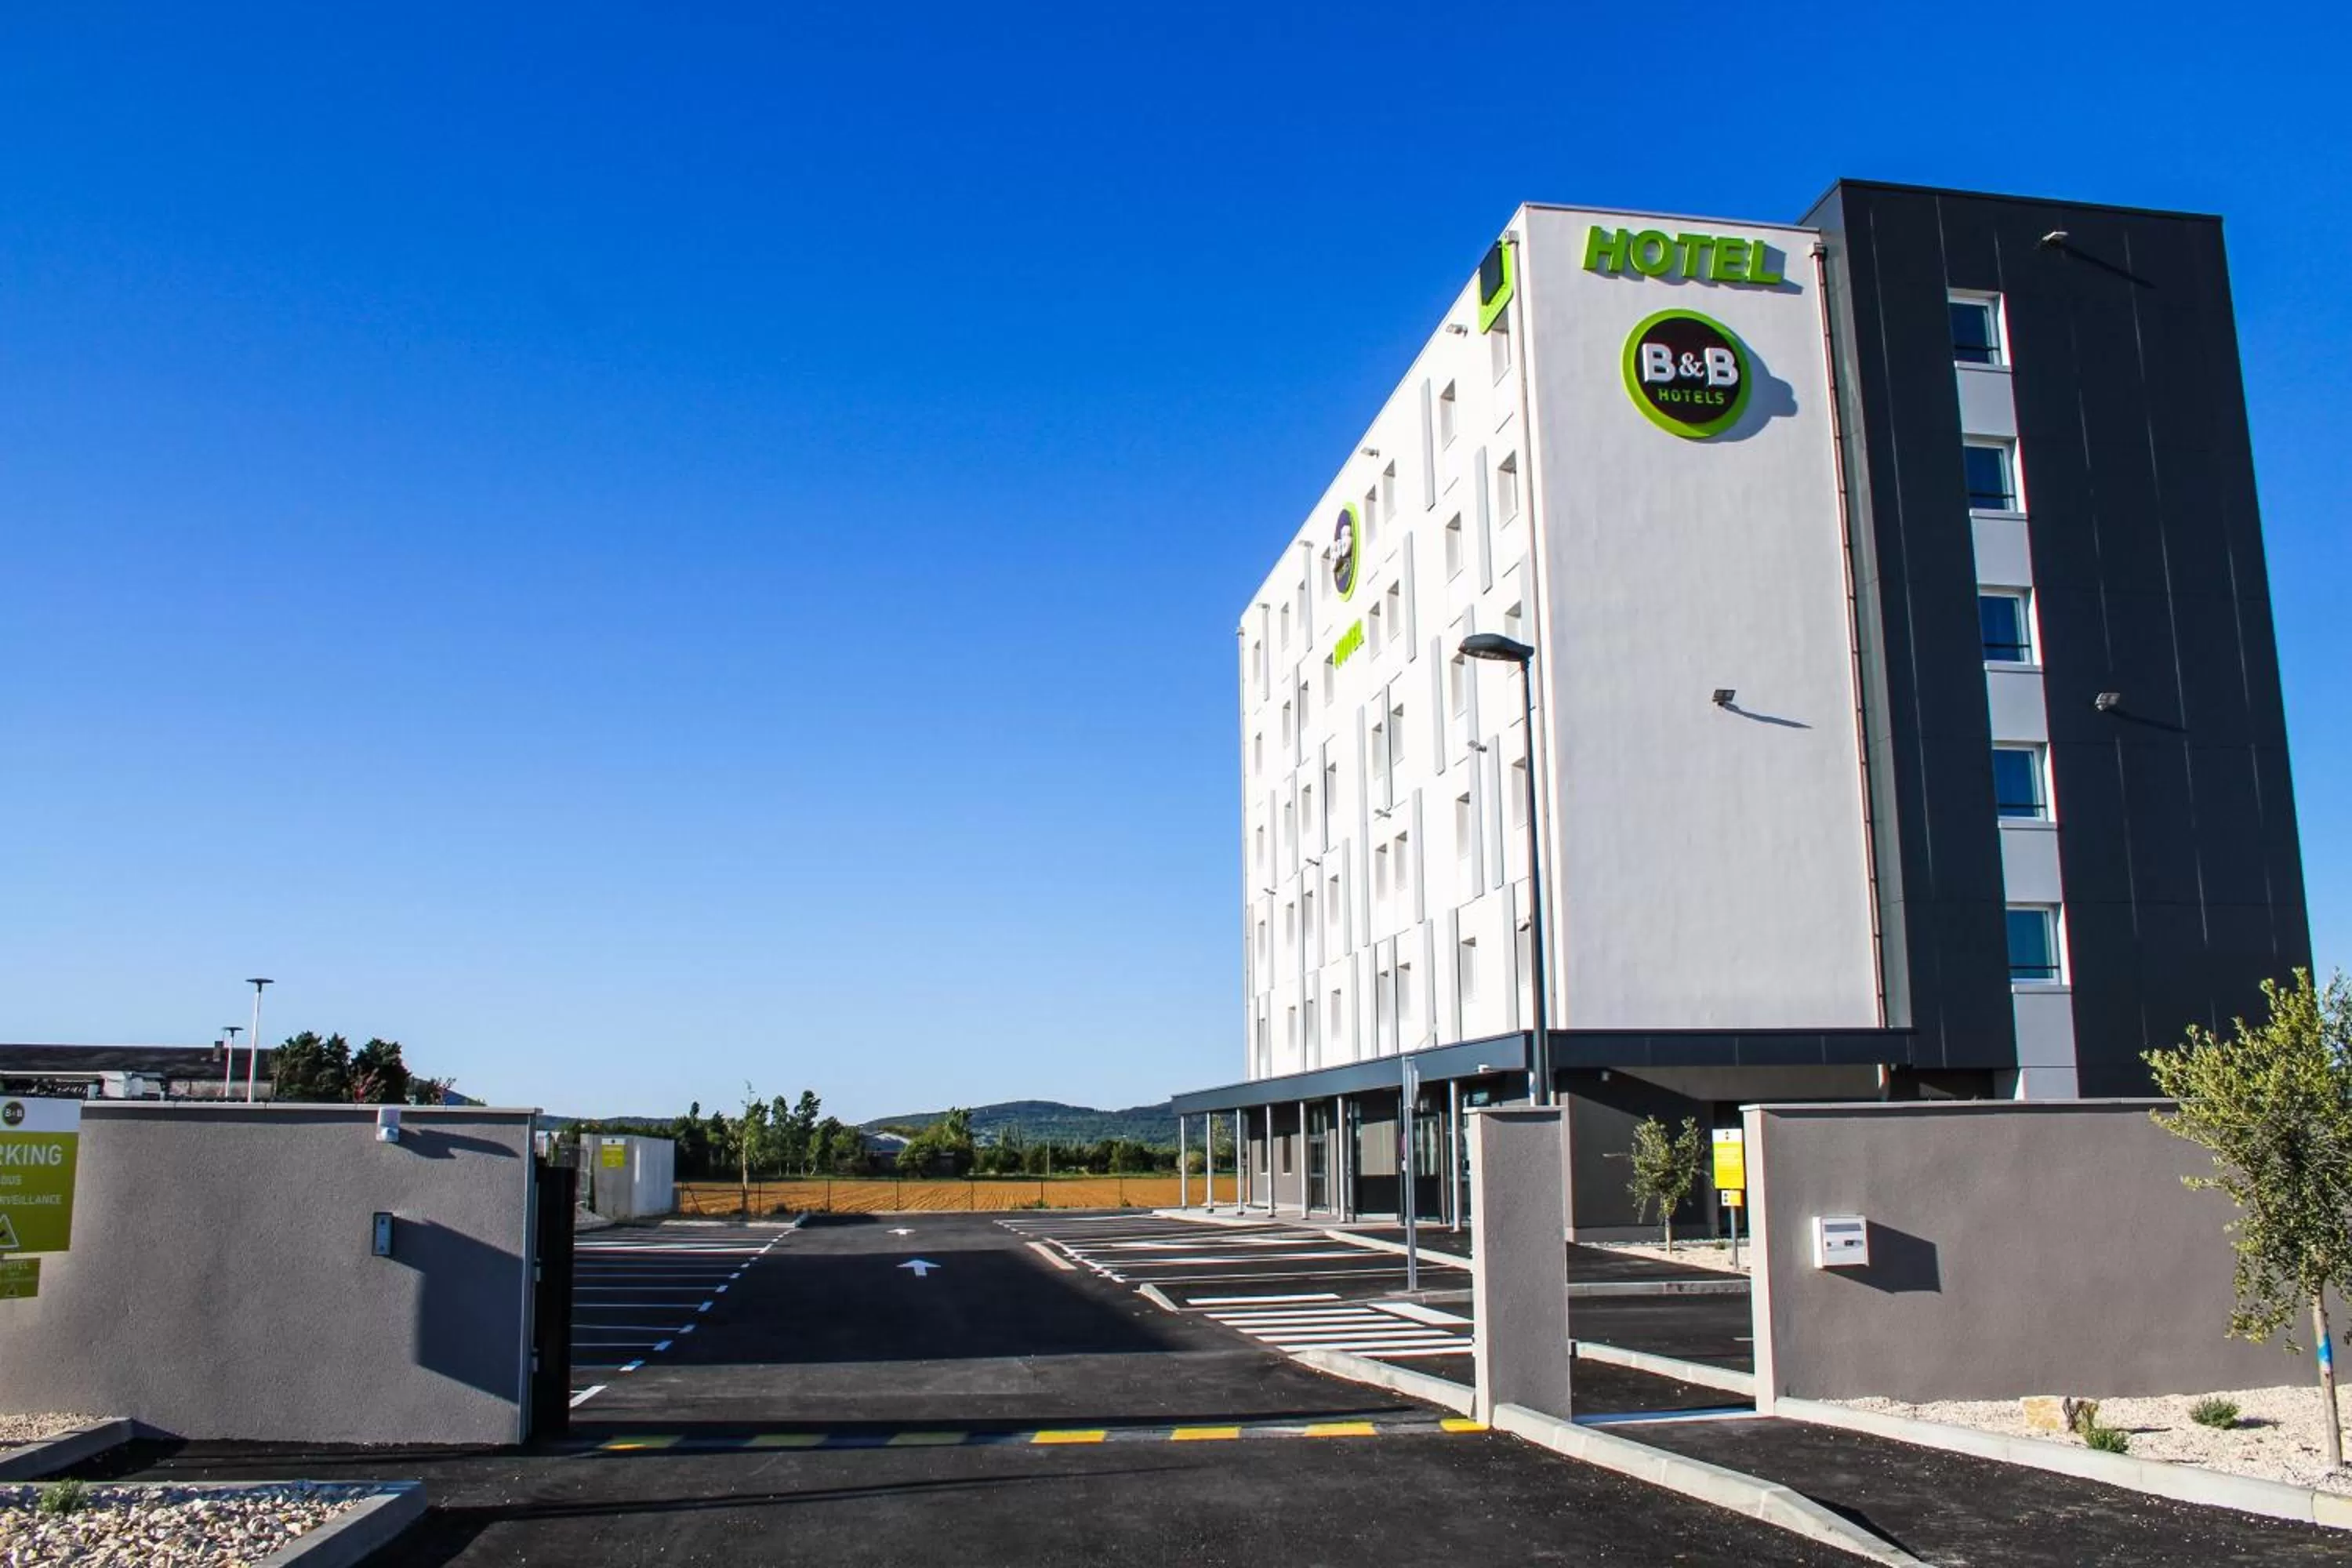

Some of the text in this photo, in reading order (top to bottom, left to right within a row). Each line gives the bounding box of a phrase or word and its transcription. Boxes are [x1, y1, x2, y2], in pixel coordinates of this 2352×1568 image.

[1582, 225, 1783, 284] HOTEL
[1642, 343, 1738, 387] B&B
[1657, 388, 1725, 405] HOTELS
[0, 1144, 63, 1166] KING
